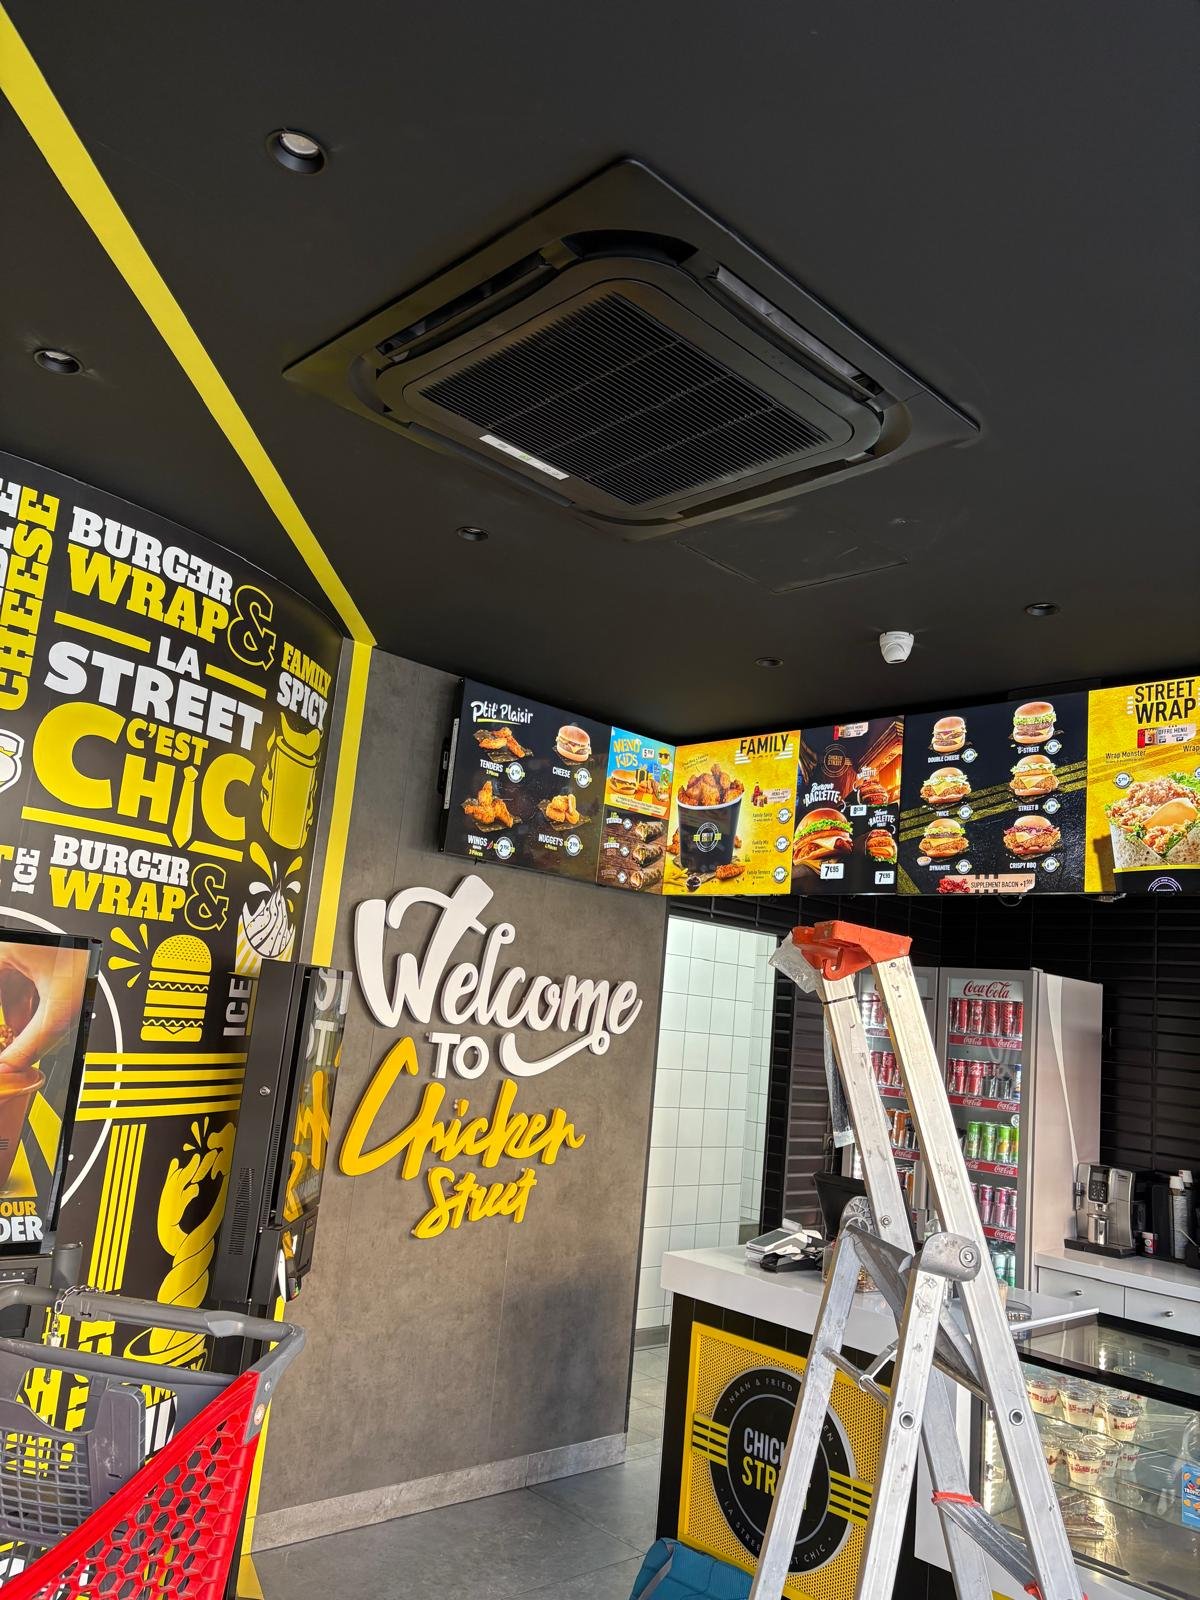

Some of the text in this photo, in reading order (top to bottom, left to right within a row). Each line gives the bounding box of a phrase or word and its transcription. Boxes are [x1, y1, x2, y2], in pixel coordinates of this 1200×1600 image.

[0, 486, 60, 711] CHEESE
[67, 543, 230, 644] WRAP
[156, 635, 201, 680] LA
[280, 641, 332, 699] FAMILY
[43, 640, 264, 751] STREET
[276, 671, 328, 731] SPICY
[1135, 679, 1195, 703] STREET
[1135, 698, 1197, 724] WRAP
[499, 704, 534, 724] Plaisir
[740, 734, 789, 756] FAMILY
[944, 754, 960, 762] CHEESE
[1105, 750, 1146, 760] Wrap Monster
[32, 701, 256, 848] CHIC
[480, 759, 504, 773] TENDERS
[552, 766, 571, 779] CHEESE
[804, 790, 841, 807] RACLETTE
[1018, 804, 1033, 812] STREET
[467, 834, 488, 847] WINGS
[11, 847, 41, 894] ICE
[970, 880, 1001, 888] SUPPLEMENT
[1001, 880, 1018, 888] BACON
[49, 866, 187, 923] WRAP
[353, 874, 643, 1076] Welcome
[963, 980, 1012, 998] Coca-Cola
[223, 978, 252, 1036] ICE
[427, 1032, 489, 1079] TO
[339, 1036, 586, 1180] Chicken
[411, 1166, 538, 1239] Street
[729, 1383, 751, 1404] NAAN
[765, 1377, 793, 1392] FRIED
[743, 1427, 785, 1466] CHIC
[742, 1455, 777, 1497] STR
[724, 1500, 761, 1552] LA STREE
[804, 1544, 826, 1562] CHIC
